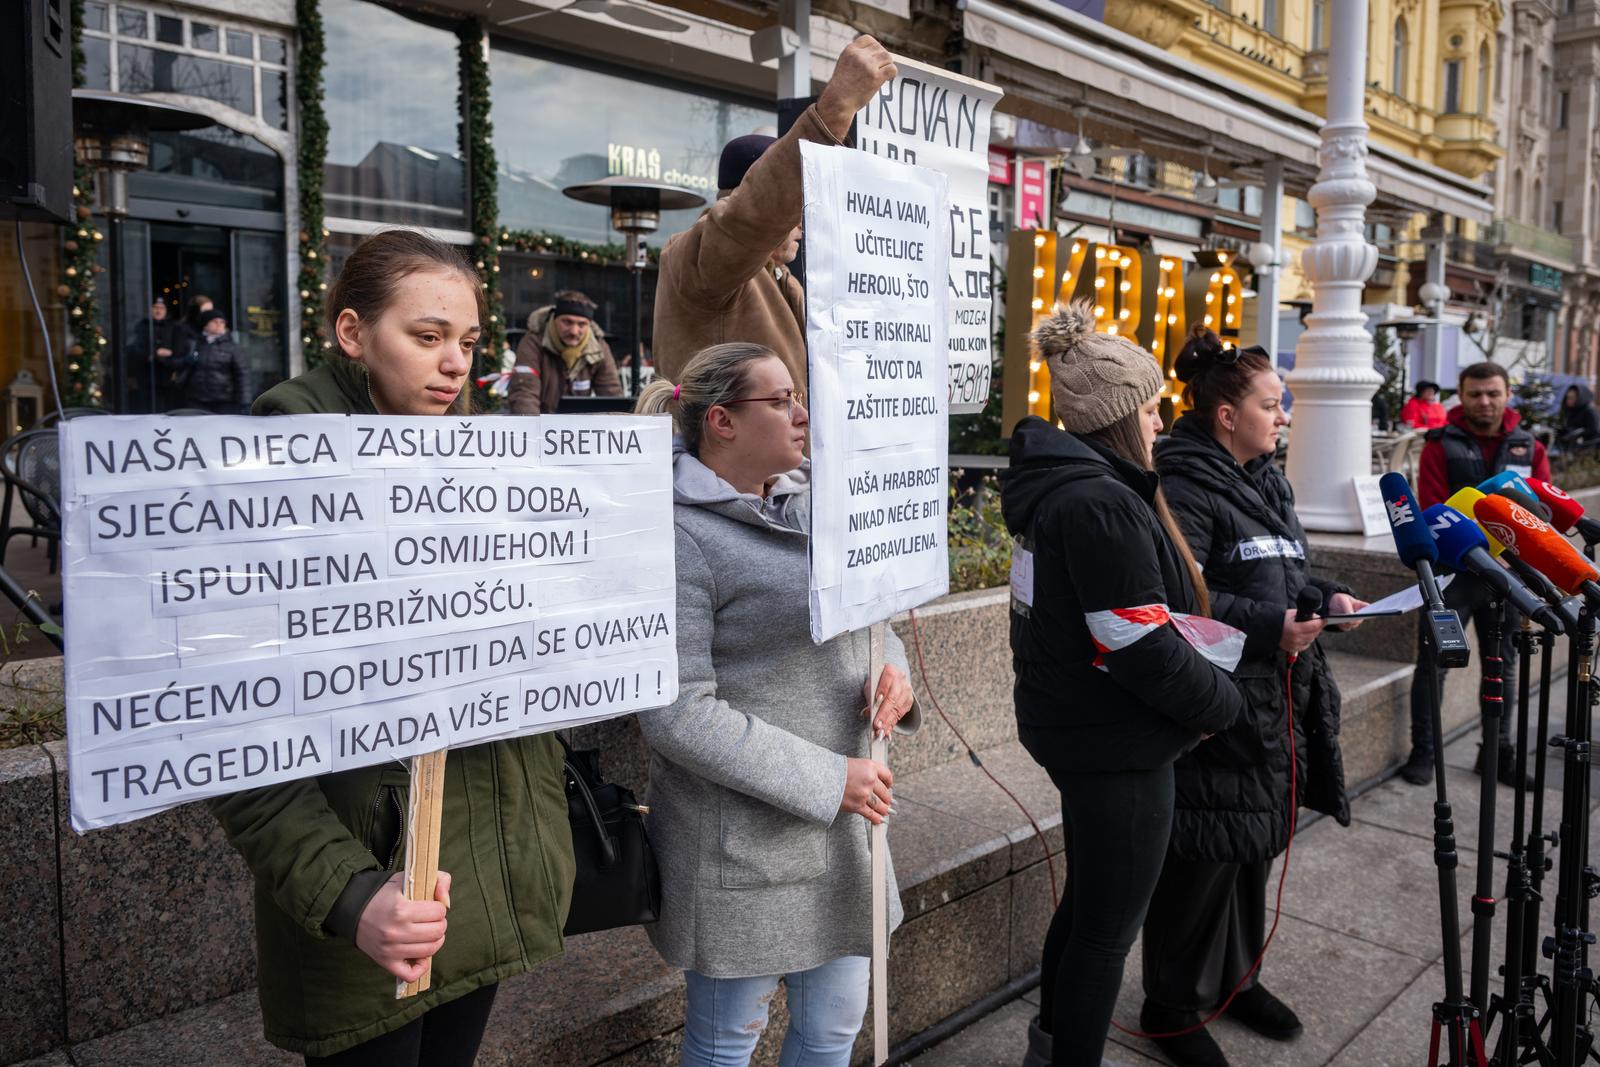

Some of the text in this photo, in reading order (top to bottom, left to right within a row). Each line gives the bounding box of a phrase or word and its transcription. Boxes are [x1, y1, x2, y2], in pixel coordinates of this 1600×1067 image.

[608, 143, 661, 180] KRAŠ
[663, 168, 708, 189] choco
[847, 191, 930, 229] HVALA VAM,
[855, 229, 924, 261] UČITELJICE
[848, 272, 929, 300] HEROJU, ŠTO
[846, 320, 931, 343] STE RISKIRALI
[955, 310, 986, 325] MOZGA
[866, 354, 923, 380] ŽIVOT DA
[847, 393, 938, 420] ZAŠTITE DJECU.
[85, 428, 207, 475] NAŠA
[356, 422, 528, 458] ZASLUŽUJU
[544, 429, 643, 456] SRETNA
[848, 467, 940, 496] VAŠA HRABROST
[98, 477, 590, 540] SJEĆANJA NA ĐAČKO DOBA,
[849, 499, 940, 532] NIKAD NEĆE BITI
[1429, 510, 1461, 541] N1
[162, 529, 589, 604] ISPUNJENA OSMIJEHOM I
[847, 532, 938, 568] ZABORAVLJENA.
[287, 579, 533, 639] BEZBRIŽNOŠĆU.
[93, 612, 670, 736] NEĆEMO DOPUSTITI DA SE OVAKVA
[91, 734, 321, 802] TRAGEDIJA
[339, 712, 441, 758] IKADA
[449, 690, 510, 732] VIŠE
[524, 676, 626, 715] PONOVI
